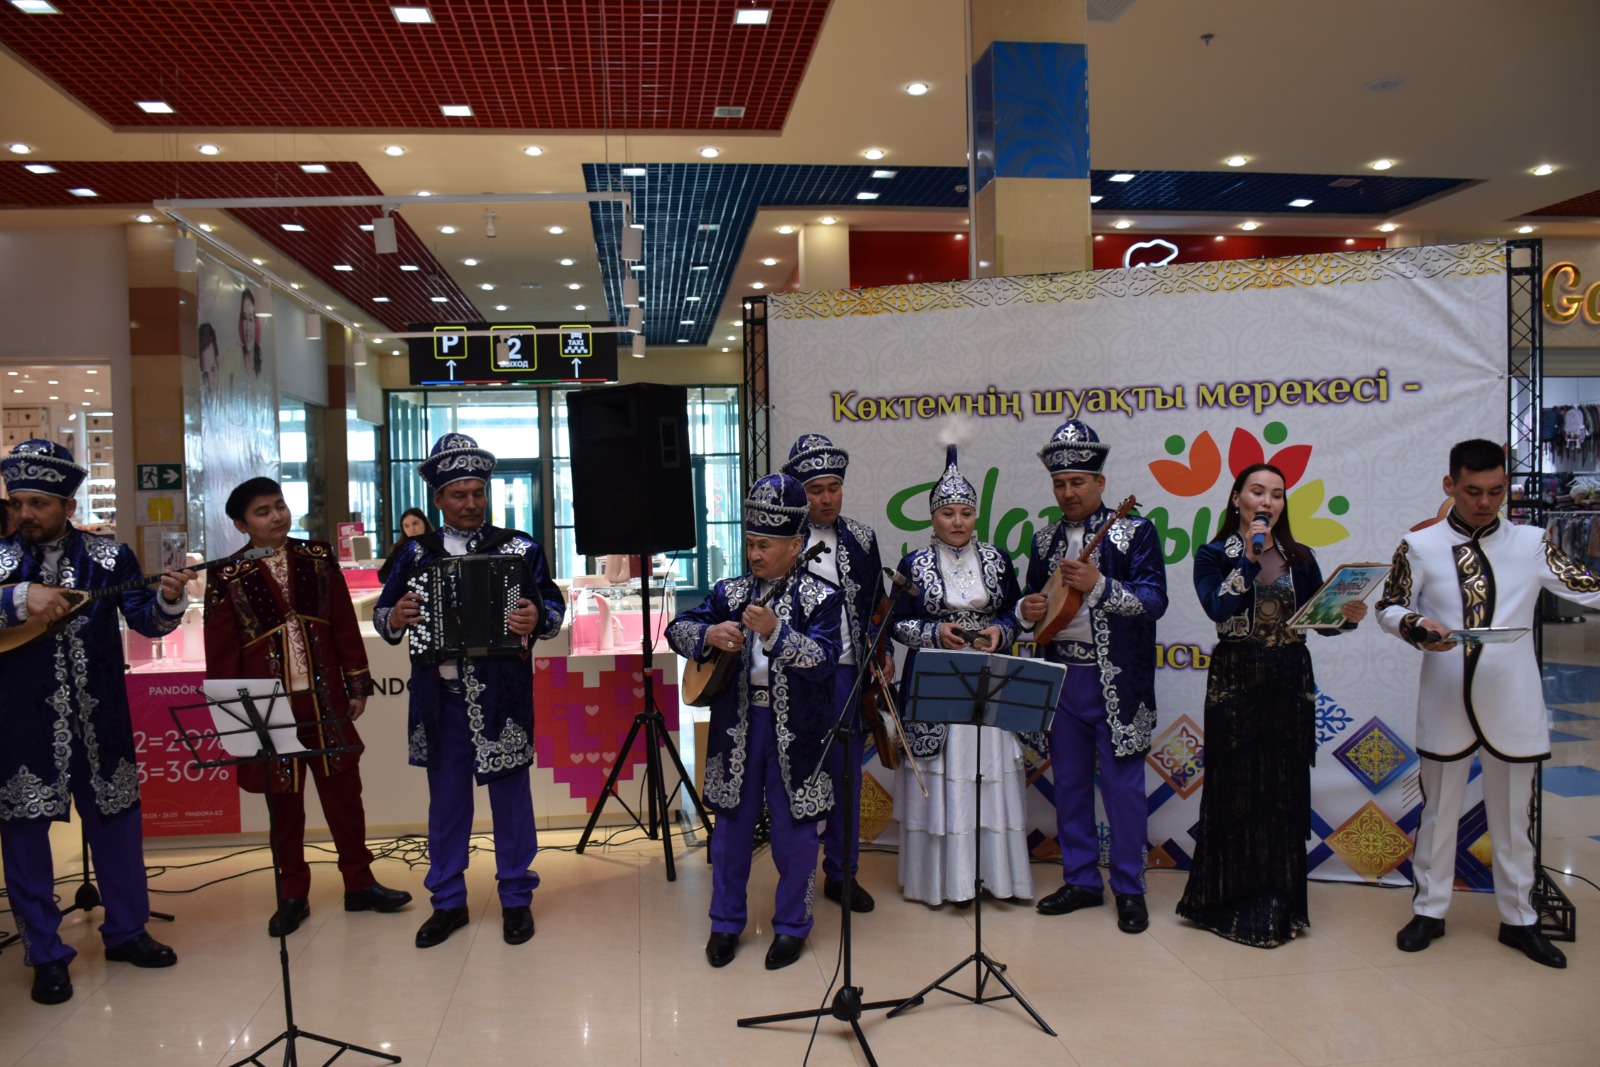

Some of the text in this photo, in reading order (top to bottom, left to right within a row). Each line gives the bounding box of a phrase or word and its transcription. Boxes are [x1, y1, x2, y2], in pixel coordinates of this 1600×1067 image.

[507, 338, 522, 359] 2
[832, 386, 1023, 421] Көктемнің
[1031, 386, 1187, 420] шуақты
[1199, 369, 1389, 414] мерекесі
